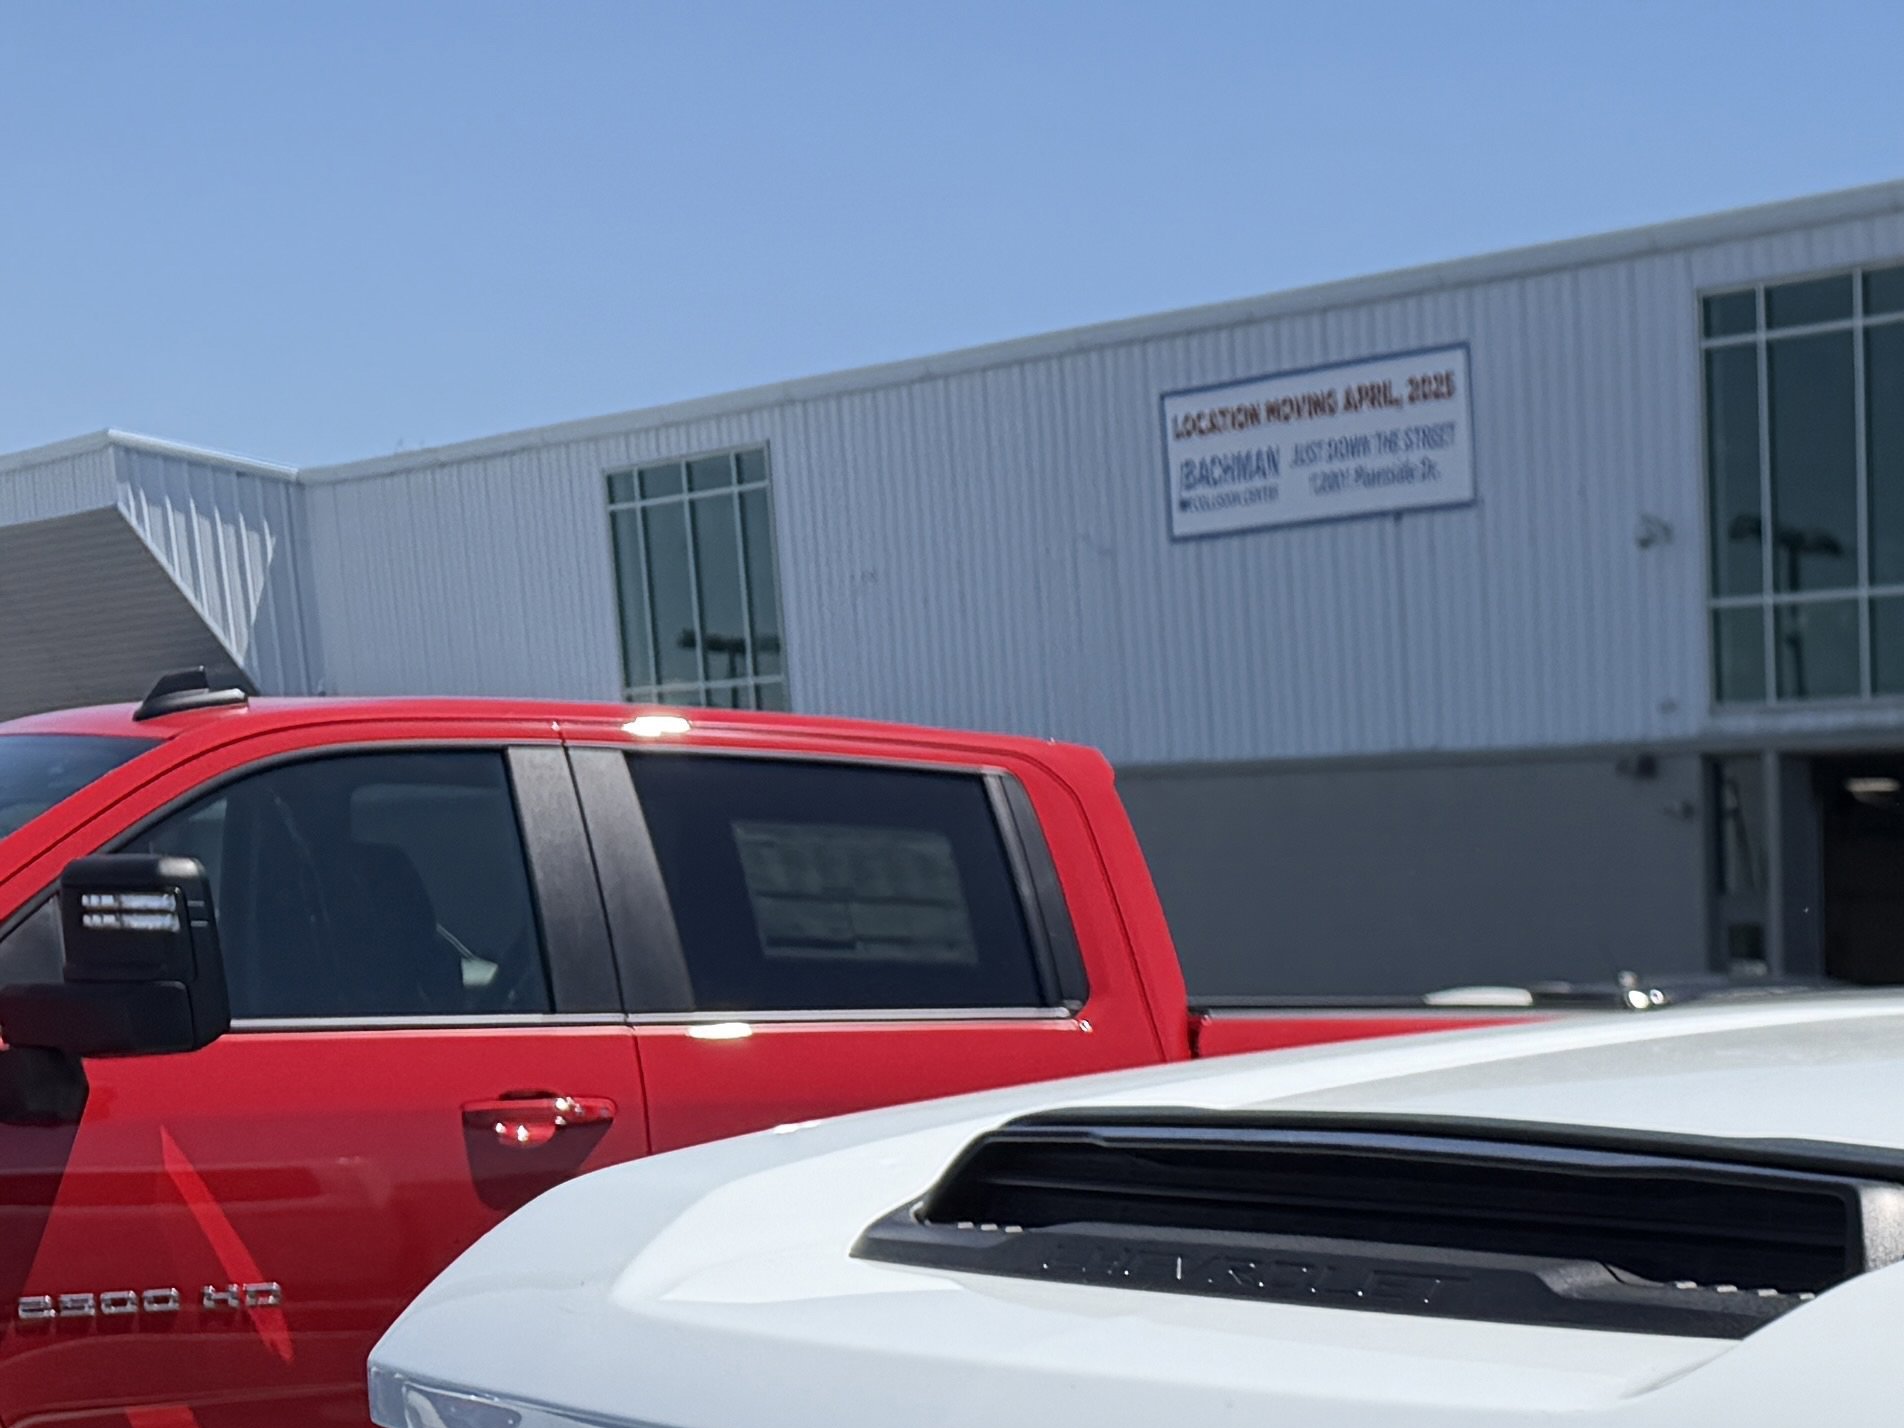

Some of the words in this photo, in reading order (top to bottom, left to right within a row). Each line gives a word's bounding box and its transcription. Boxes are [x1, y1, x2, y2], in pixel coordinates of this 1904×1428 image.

[1172, 402, 1261, 441] LOCATION
[1265, 388, 1337, 424] MOVING
[1407, 369, 1455, 405] 2025
[1374, 428, 1399, 455] THE
[1403, 421, 1456, 451] STREET
[1180, 445, 1280, 491] BACHMAN
[202, 1281, 282, 1310] HD
